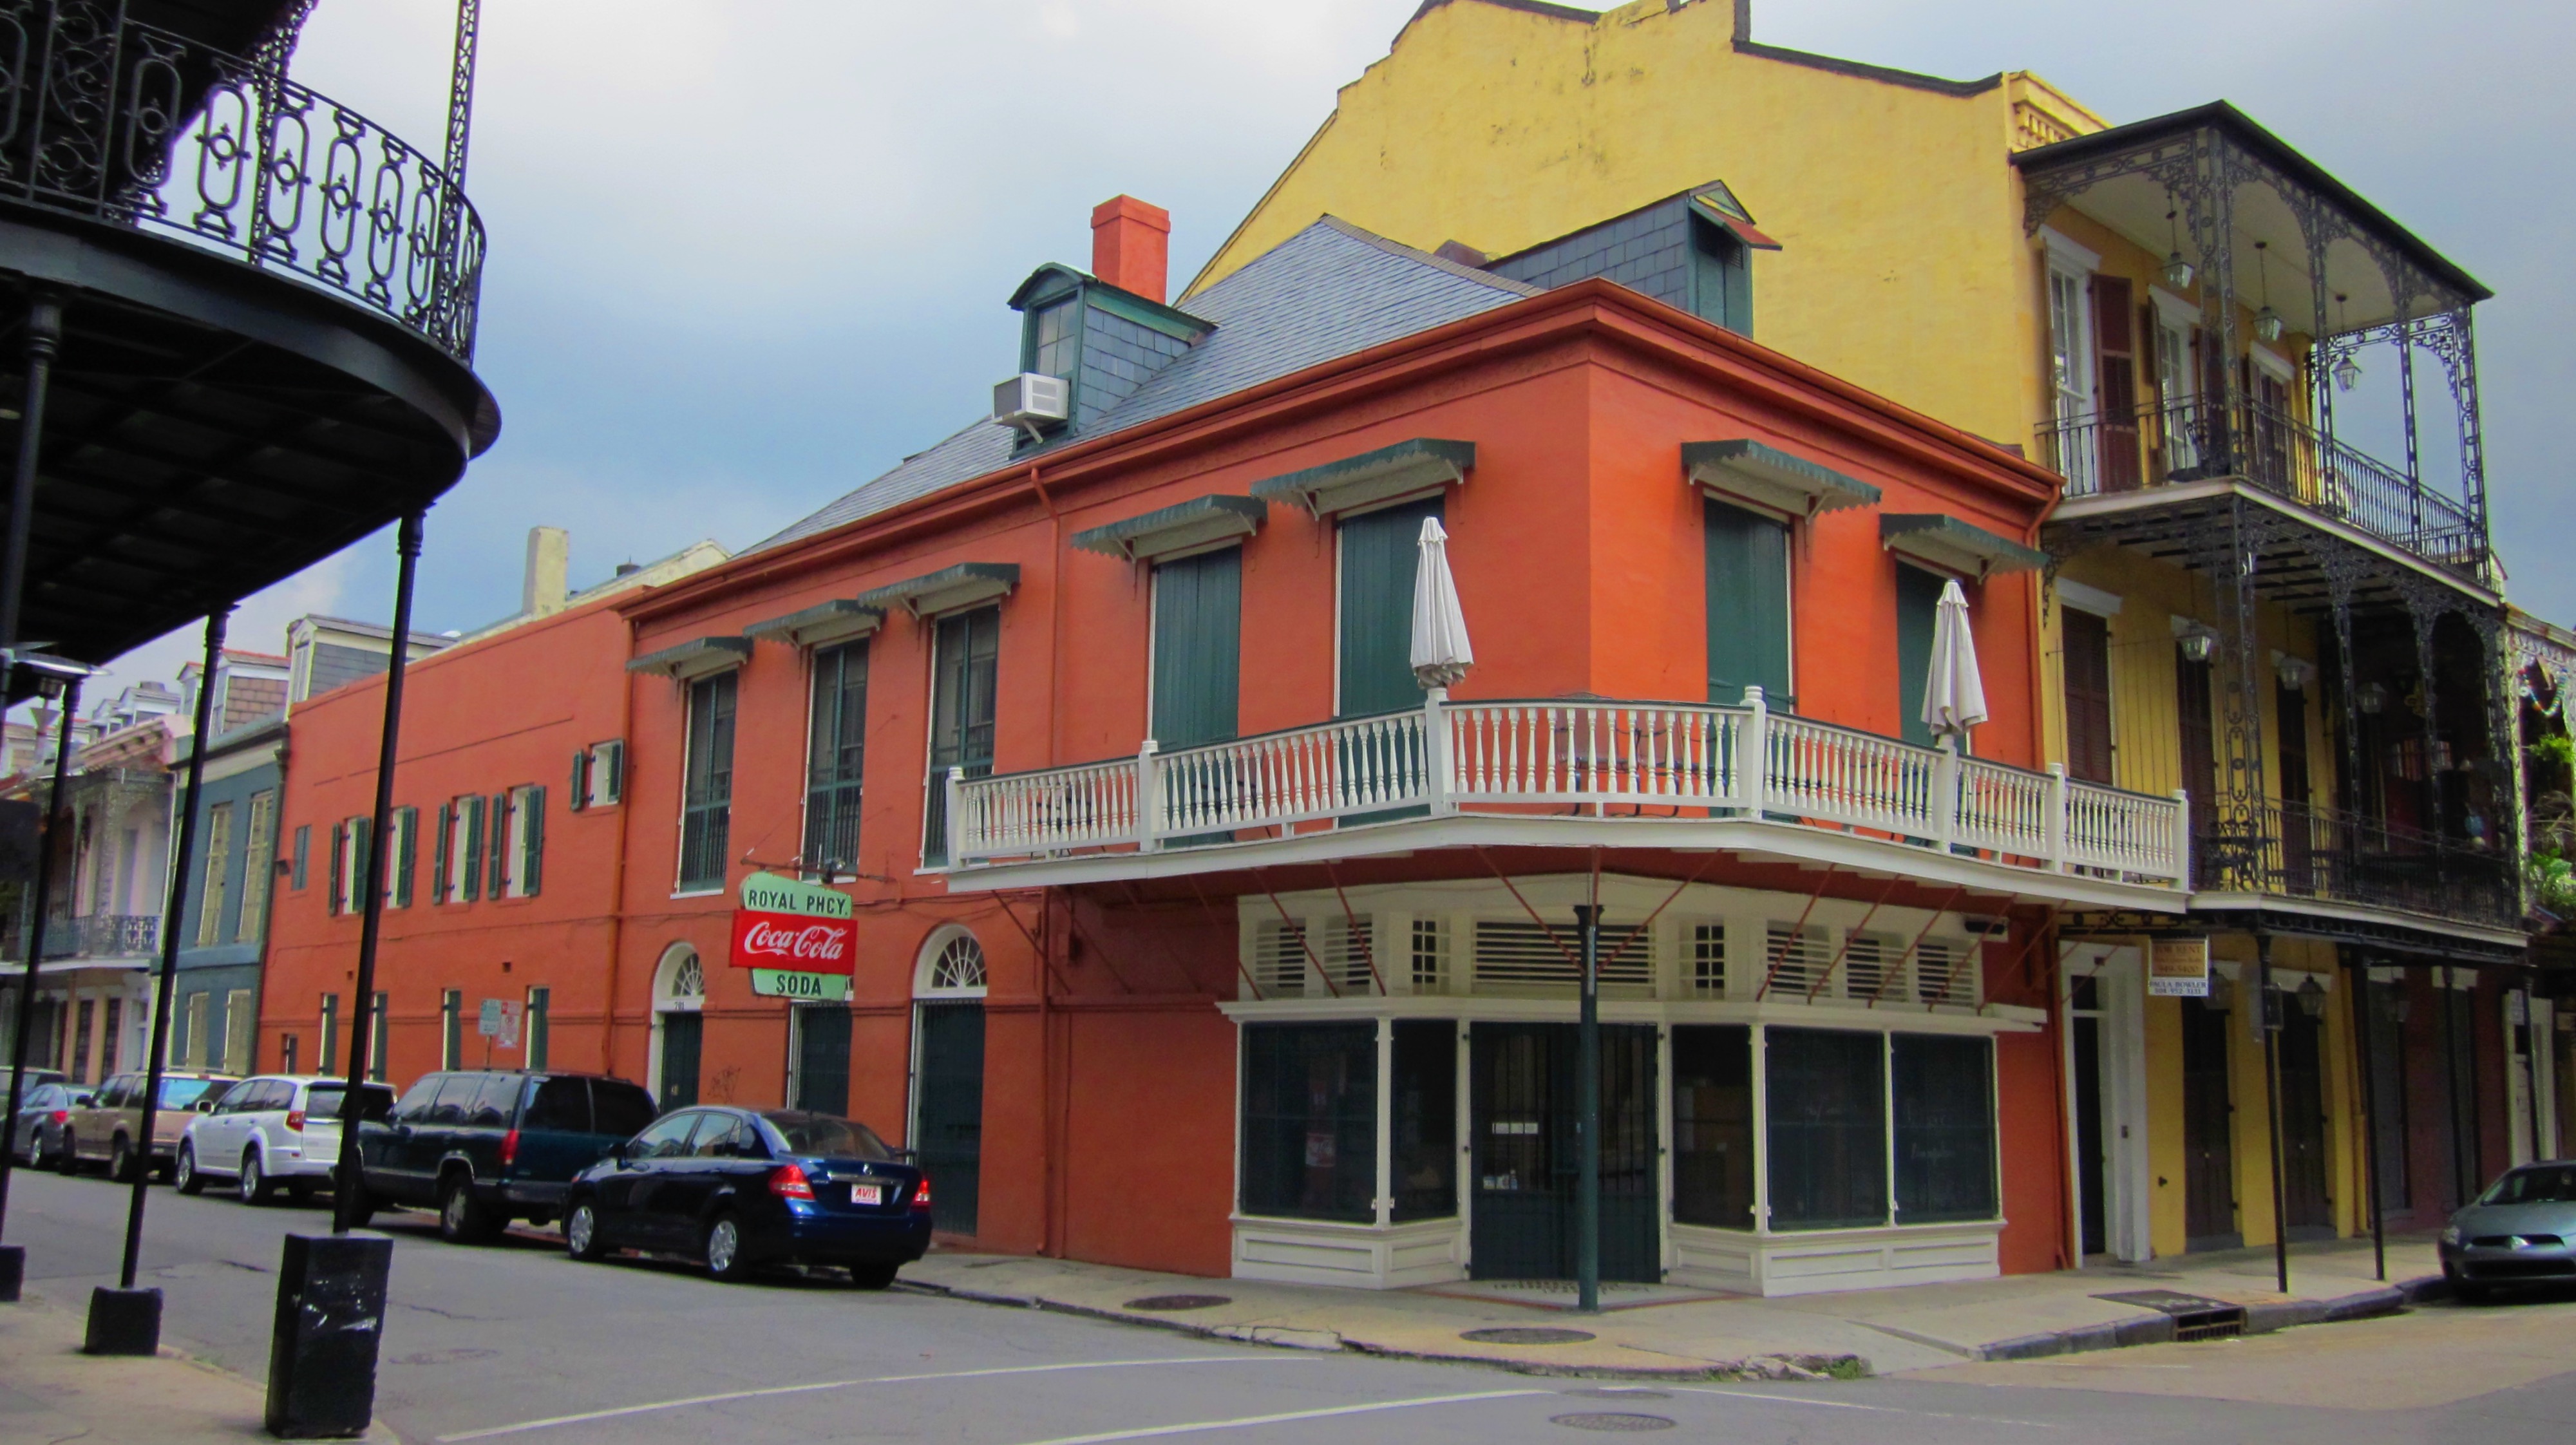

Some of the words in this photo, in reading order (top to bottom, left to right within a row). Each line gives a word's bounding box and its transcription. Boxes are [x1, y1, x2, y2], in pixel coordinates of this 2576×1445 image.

[748, 889, 797, 910] ROYAL
[806, 896, 848, 916] PHCY.
[744, 921, 848, 959] Coca-Cola
[2154, 945, 2172, 954] FOR
[2176, 945, 2201, 954] RENT
[776, 974, 822, 996] SODA
[855, 1186, 877, 1199] AVIS
